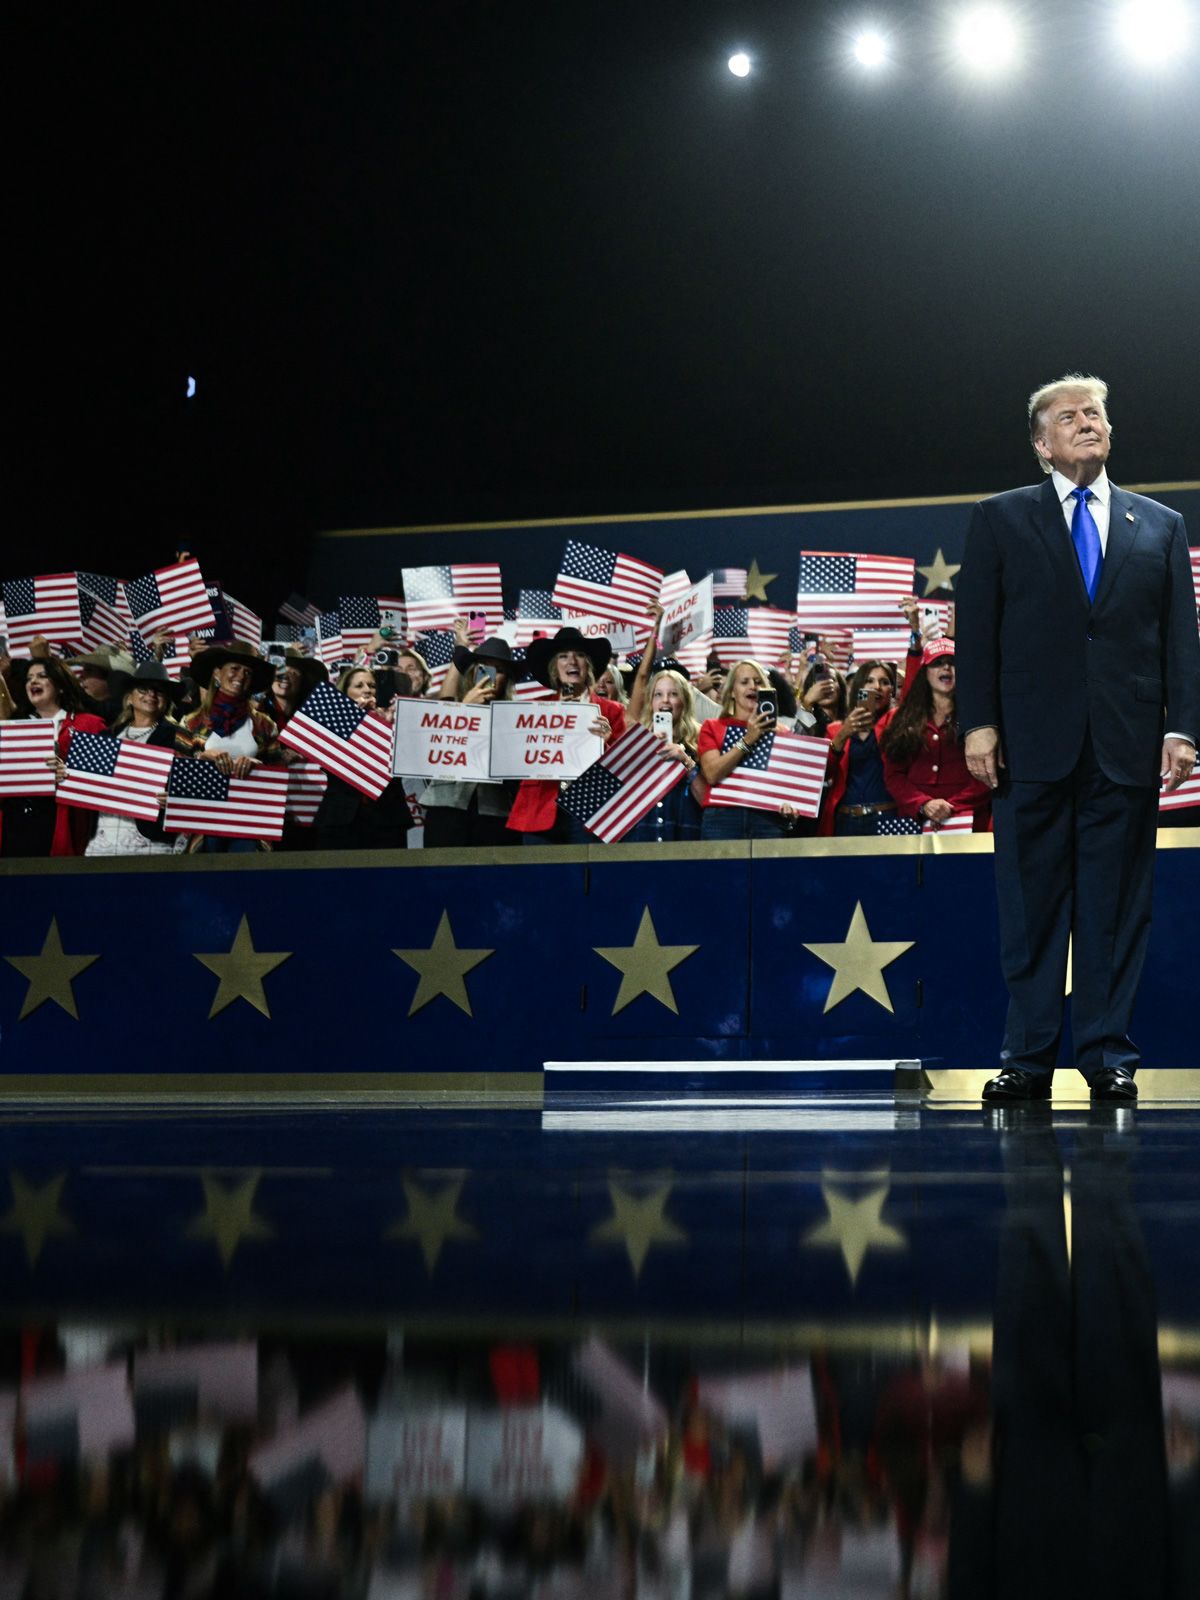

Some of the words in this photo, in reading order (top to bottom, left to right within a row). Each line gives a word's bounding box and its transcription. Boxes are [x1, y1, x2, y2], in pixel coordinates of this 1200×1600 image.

[666, 592, 699, 623] MADE
[578, 622, 627, 636] JORITY
[421, 713, 481, 731] MADE
[516, 714, 577, 729] MADE
[430, 734, 443, 743] IN
[446, 735, 469, 745] THE
[526, 735, 538, 744] IN
[542, 735, 564, 744] THE
[428, 750, 467, 766] USA
[524, 749, 564, 765] USA
